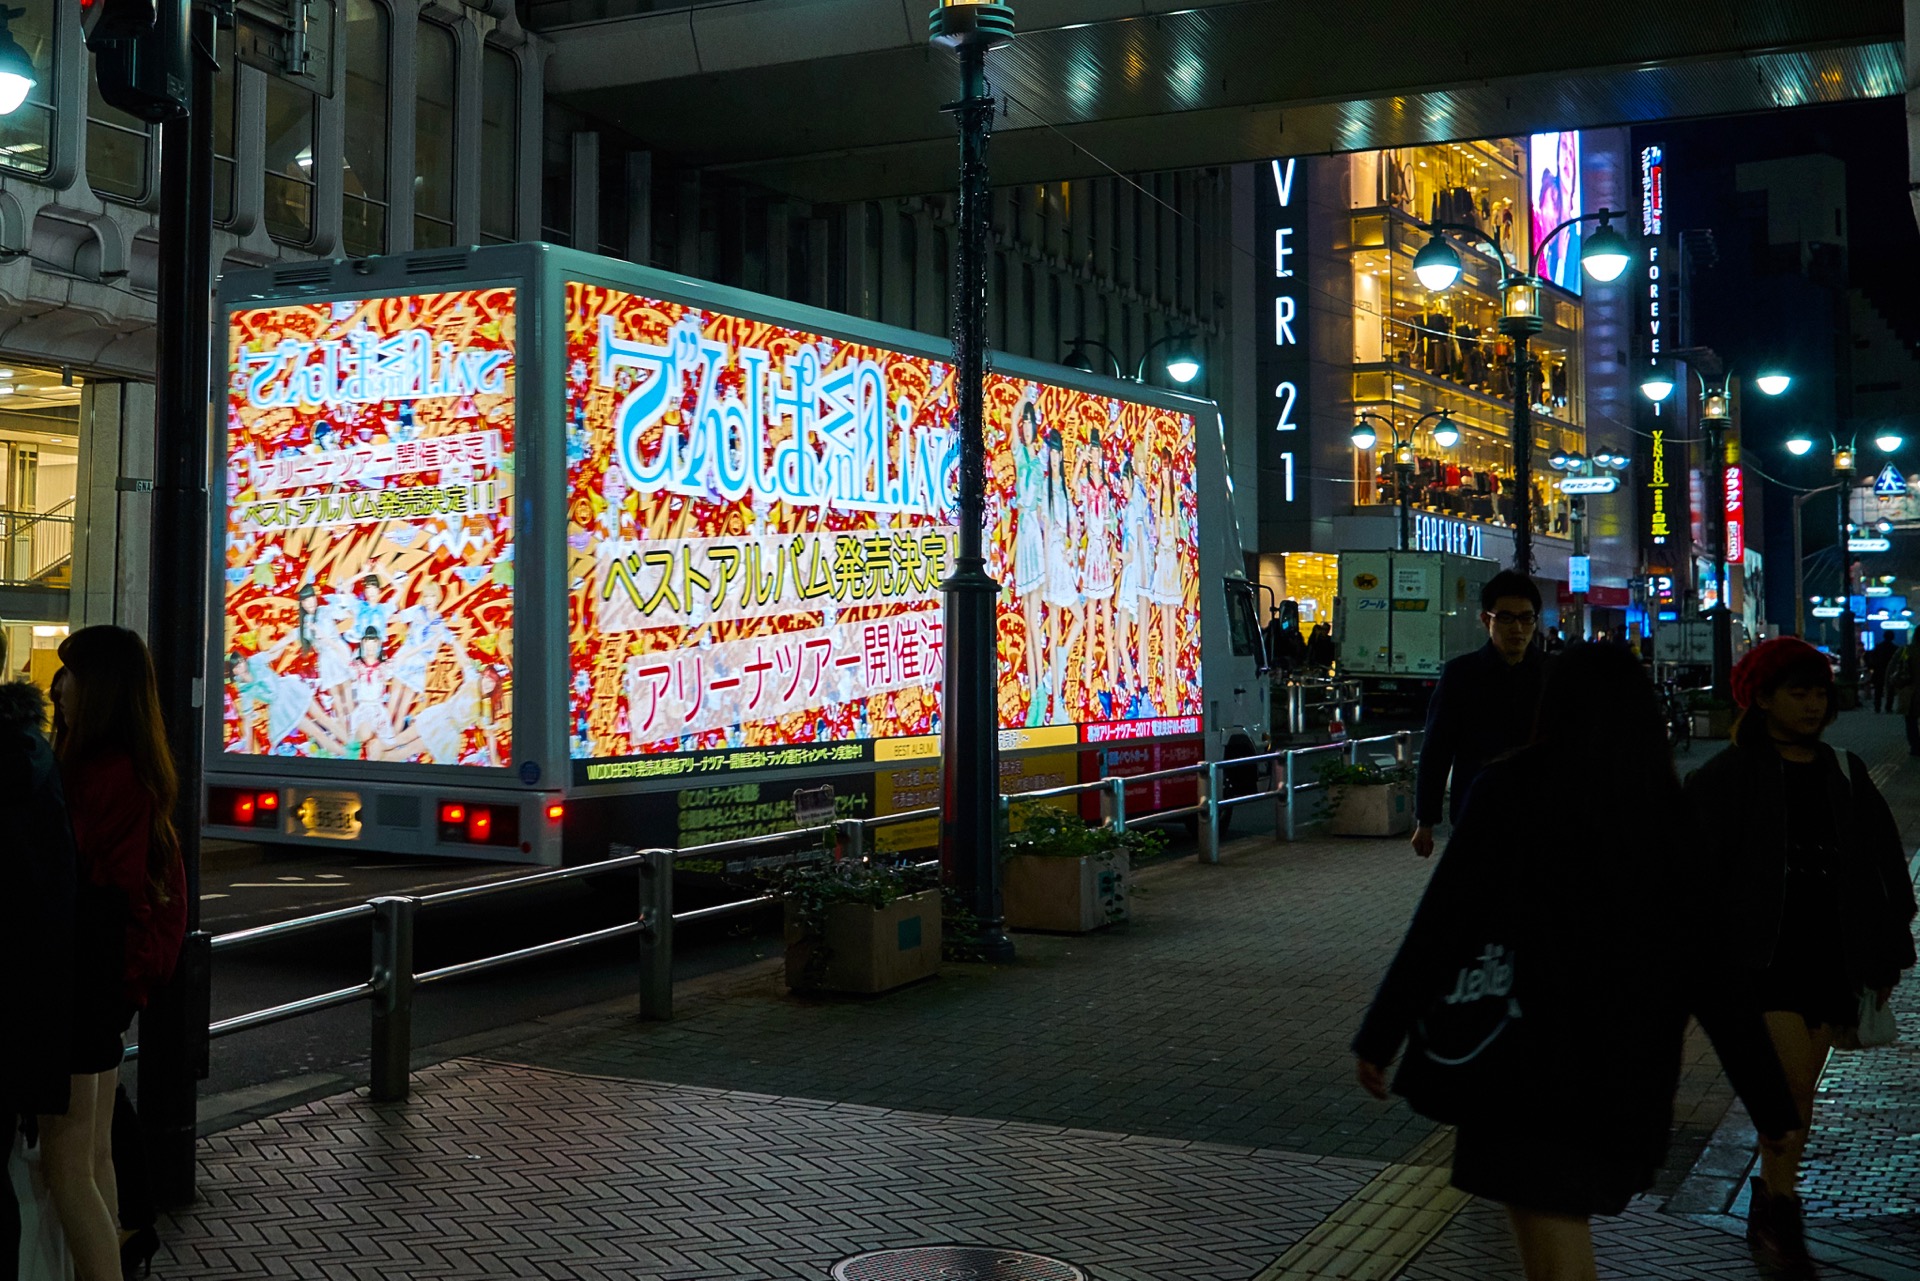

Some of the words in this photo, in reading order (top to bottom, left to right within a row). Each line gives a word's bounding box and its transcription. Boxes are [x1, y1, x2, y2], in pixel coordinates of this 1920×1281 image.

[1725, 467, 1740, 512] カラオケ
[1415, 514, 1467, 555] FOREVER
[1359, 599, 1387, 610] クール
